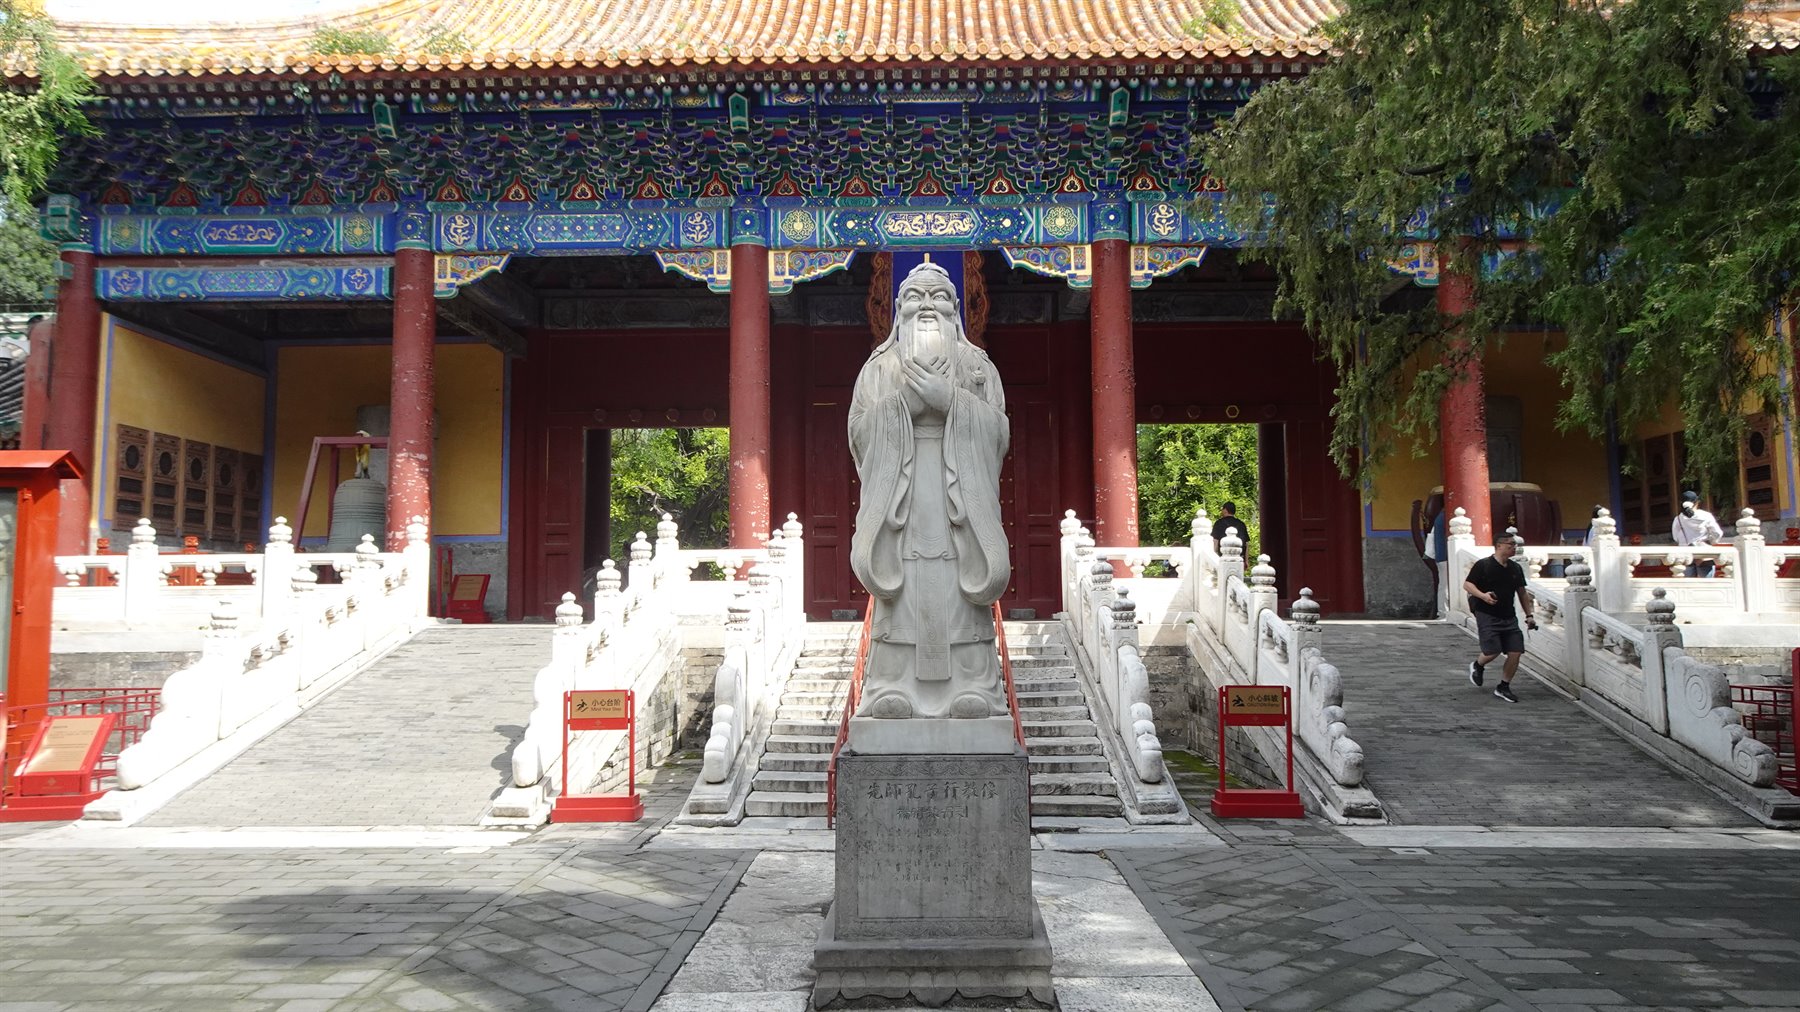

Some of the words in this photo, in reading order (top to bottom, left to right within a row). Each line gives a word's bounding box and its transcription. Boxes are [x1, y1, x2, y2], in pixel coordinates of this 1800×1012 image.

[591, 698, 621, 706] 小心台阶
[1248, 694, 1279, 702] 小心斜坡
